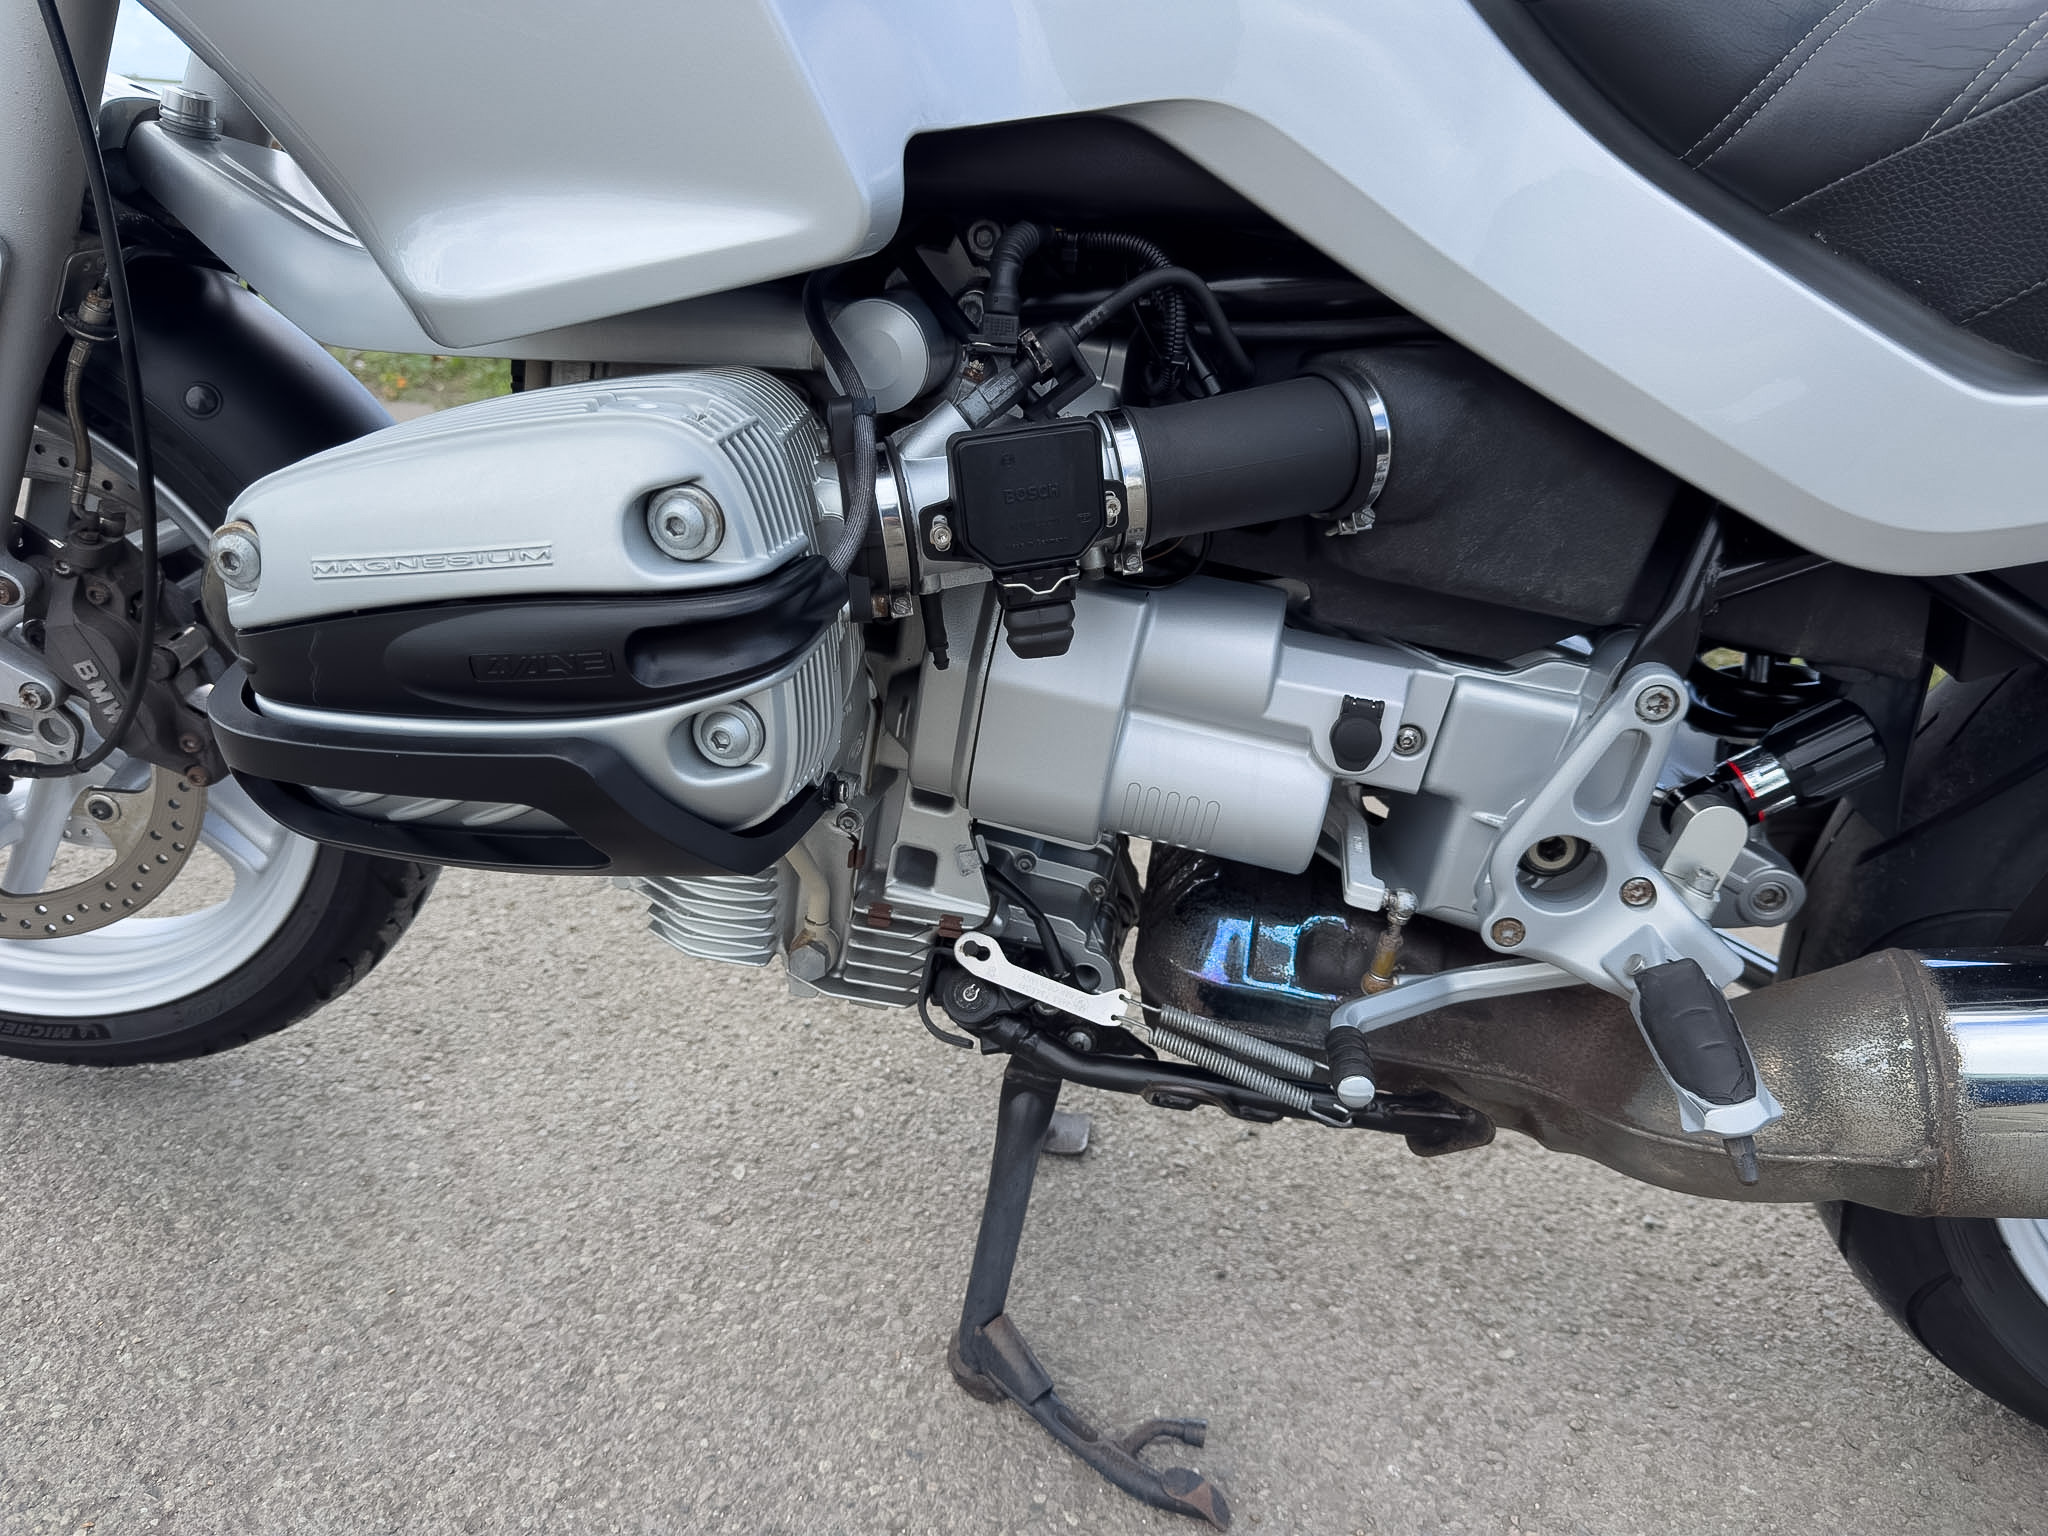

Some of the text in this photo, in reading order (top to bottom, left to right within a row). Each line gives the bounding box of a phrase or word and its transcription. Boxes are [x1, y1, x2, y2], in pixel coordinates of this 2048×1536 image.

[1001, 482, 1060, 504] BOSCH
[311, 549, 552, 574] MAGNESIUM
[73, 659, 123, 724] BMW
[0, 1020, 73, 1039] MICHE
